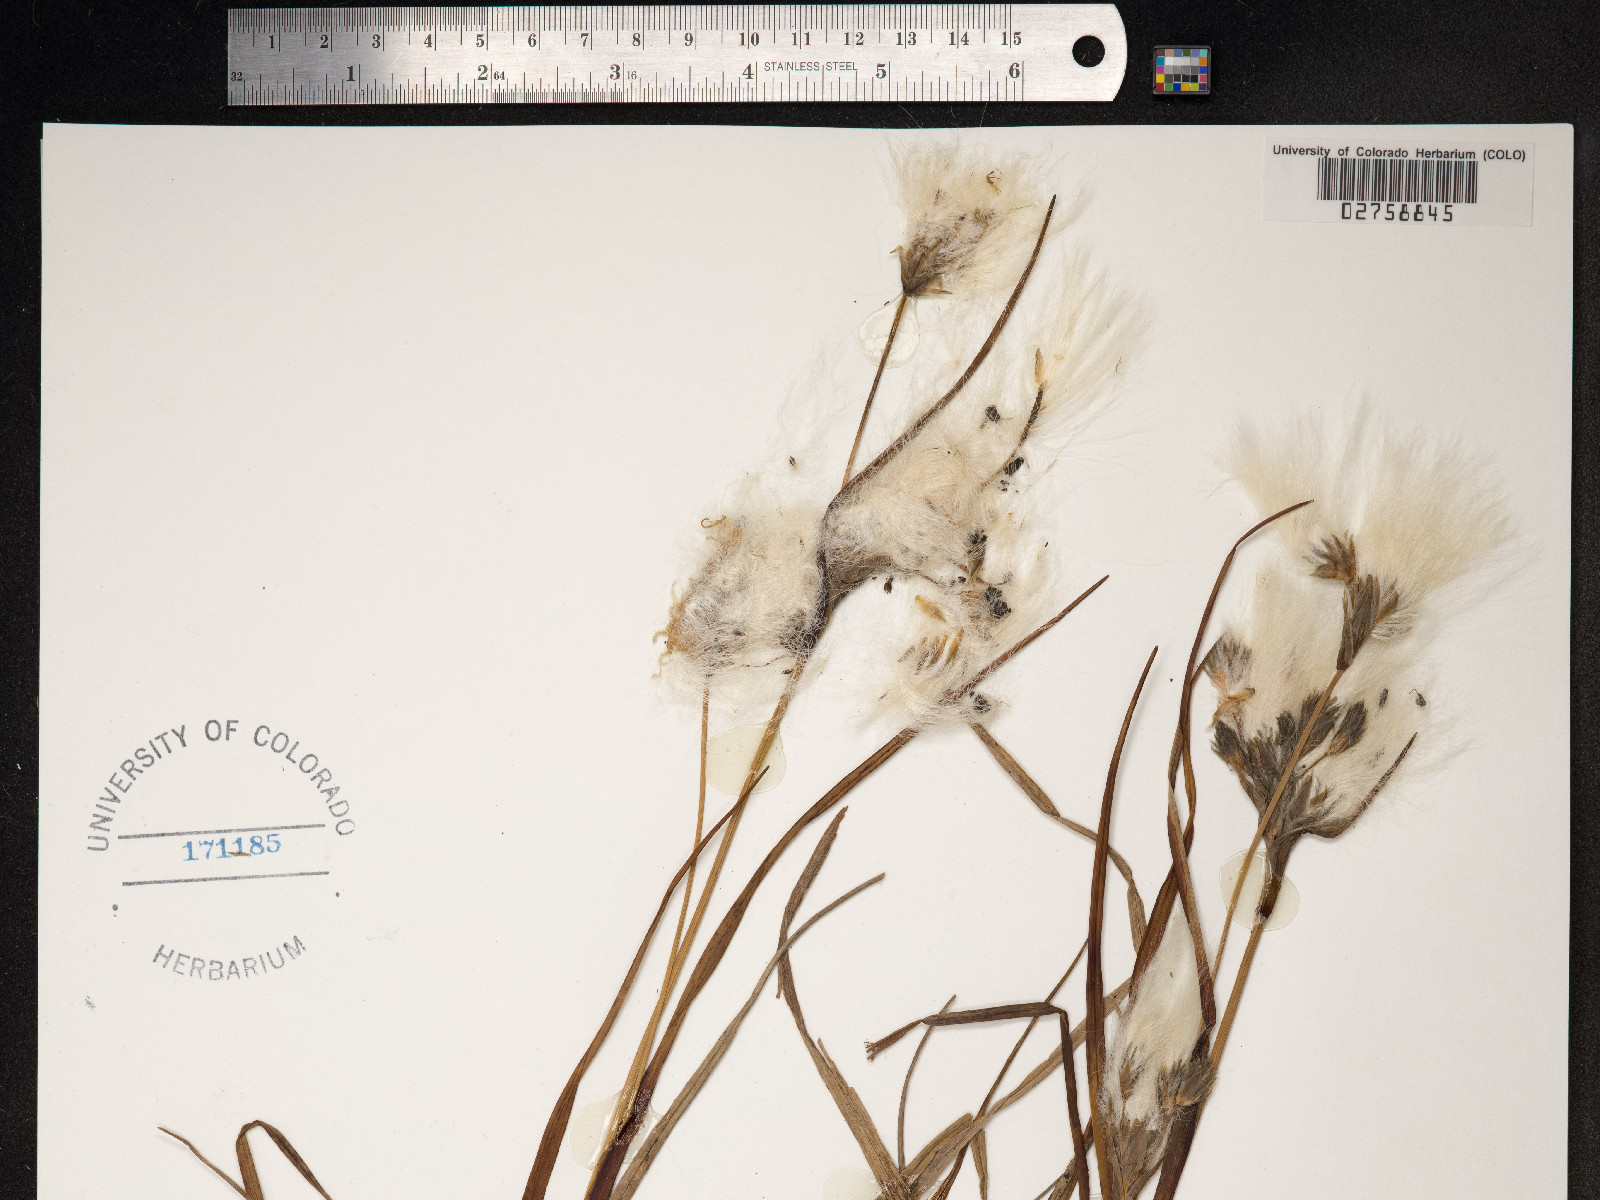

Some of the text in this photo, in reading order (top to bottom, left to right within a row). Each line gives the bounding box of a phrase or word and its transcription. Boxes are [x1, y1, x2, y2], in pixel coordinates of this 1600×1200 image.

[268, 31, 1022, 49] 1 2 3 4 5 6 7 8 9 10 11 12 13 14 15
[230, 63, 755, 82] 32 1 2 64 3 16 4
[763, 61, 859, 72] STAINLESS STEEL
[875, 62, 1021, 79] 5 6
[1272, 144, 1527, 163] University of Colorado Herbarium (COLO)
[87, 719, 356, 852] UNIVERSITY OF COLORADO
[182, 833, 283, 862] 171185
[152, 935, 307, 981] HERBARIUM
